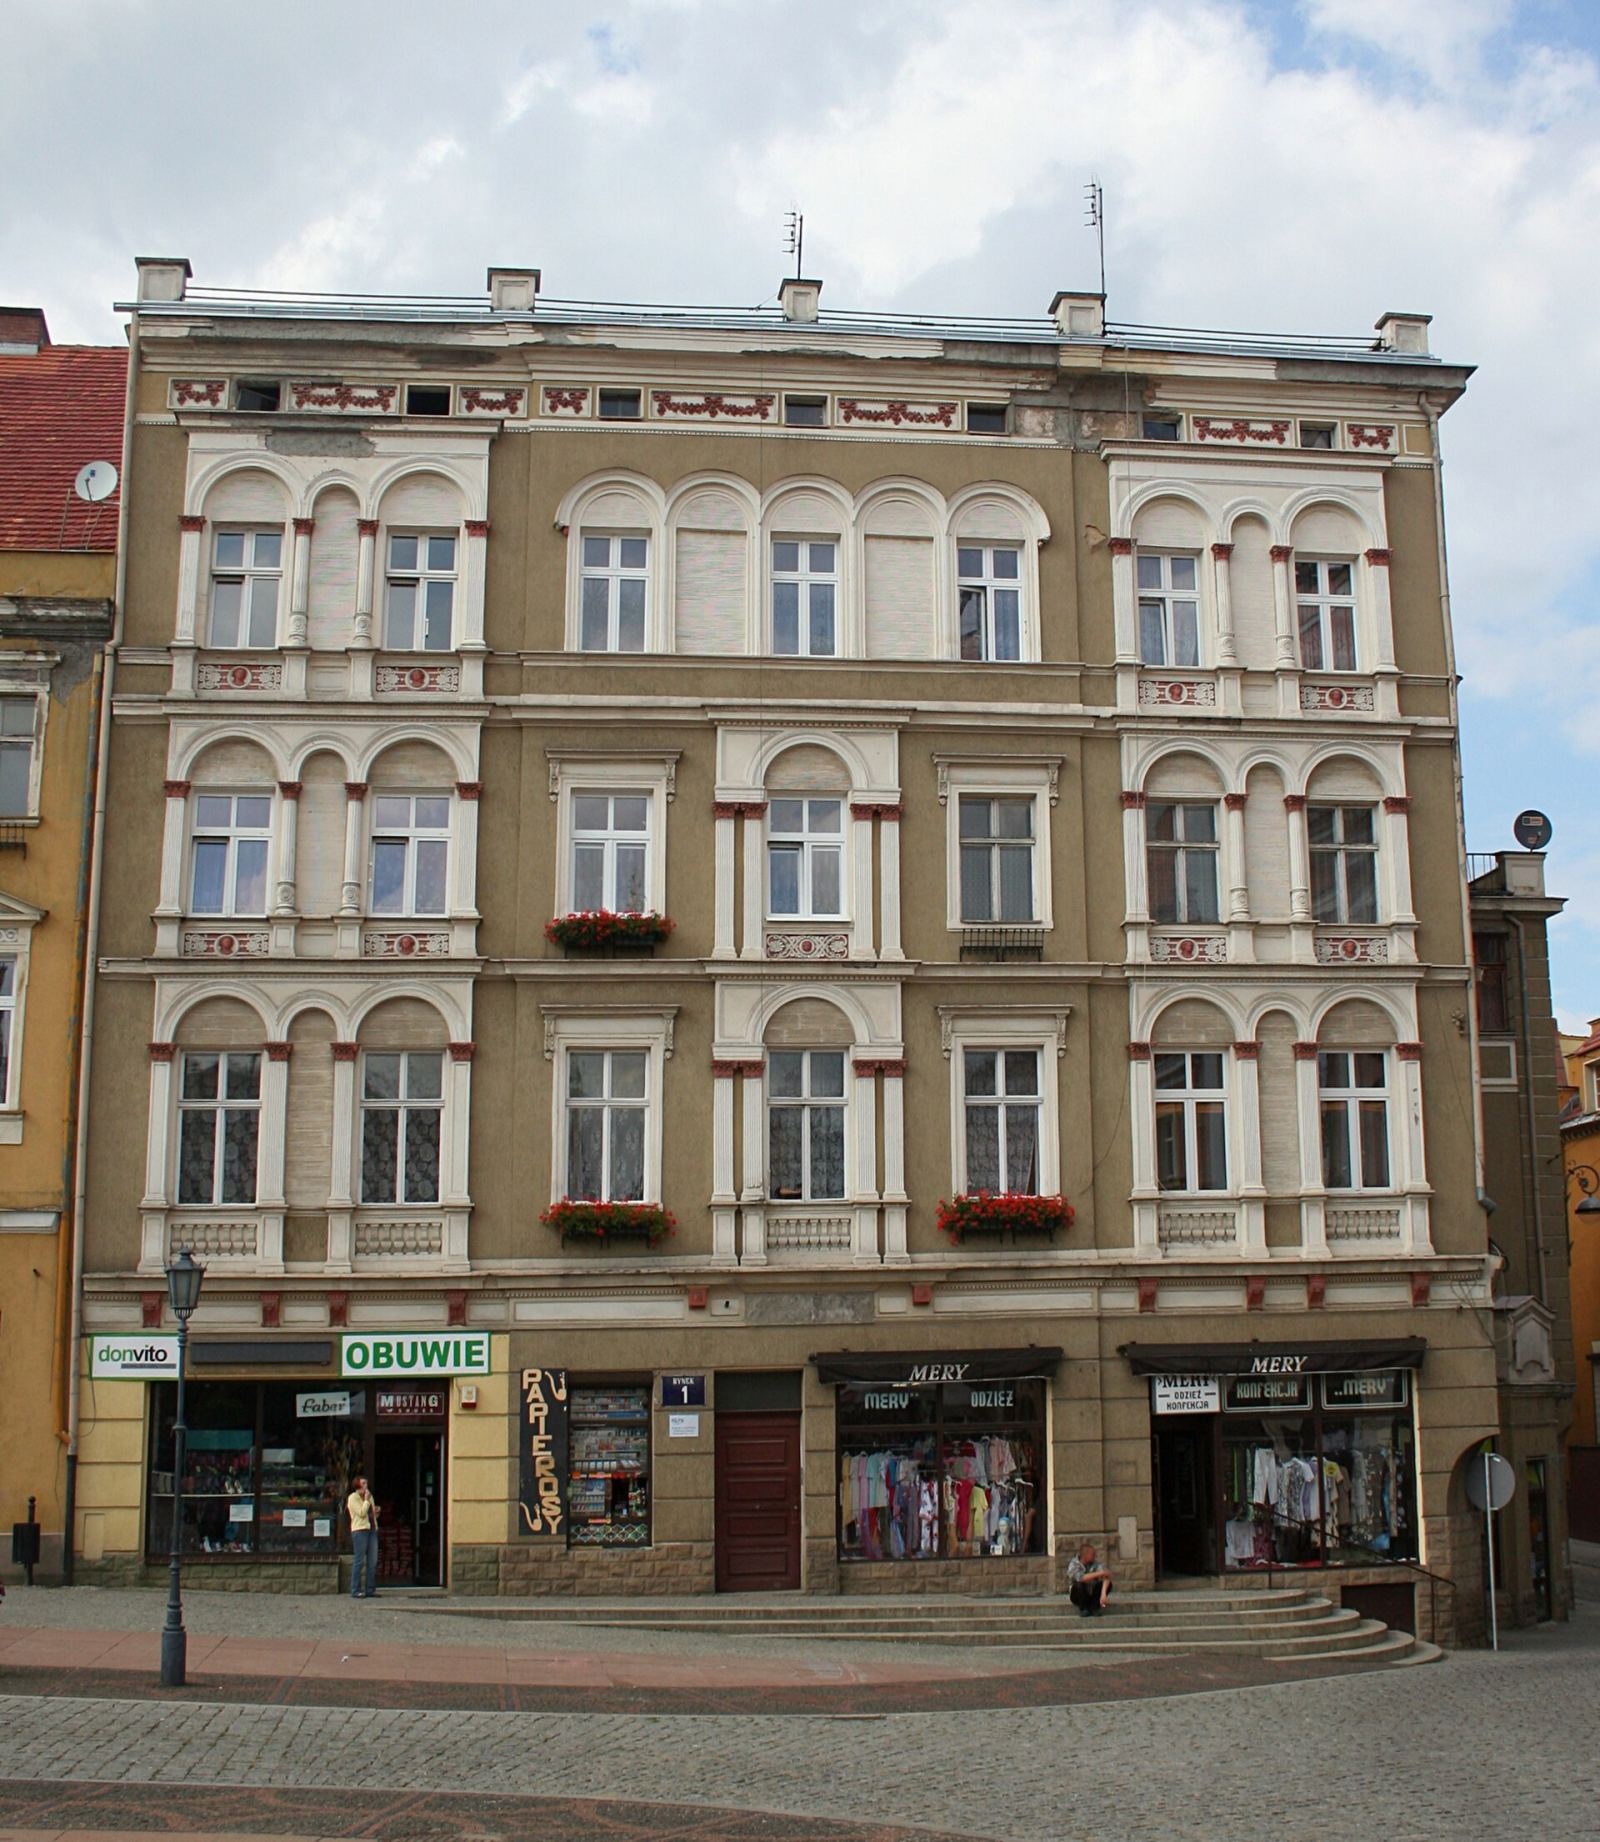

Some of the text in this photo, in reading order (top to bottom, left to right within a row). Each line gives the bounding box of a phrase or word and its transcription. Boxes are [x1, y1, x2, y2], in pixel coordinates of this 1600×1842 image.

[98, 1345, 168, 1362] donvito
[346, 1340, 485, 1369] OBUWIE
[909, 1364, 970, 1381] MERY
[1251, 1356, 1308, 1374] MERY
[672, 1377, 695, 1385] RYNEK
[681, 1385, 688, 1404] 1
[1174, 1389, 1202, 1400] ODZIEŻ
[1236, 1382, 1298, 1399] KONFEKCJA
[380, 1395, 438, 1407] MUSTANG
[1166, 1400, 1209, 1411] KONFEKCJA
[522, 1368, 563, 1535] PAPIEROSY
